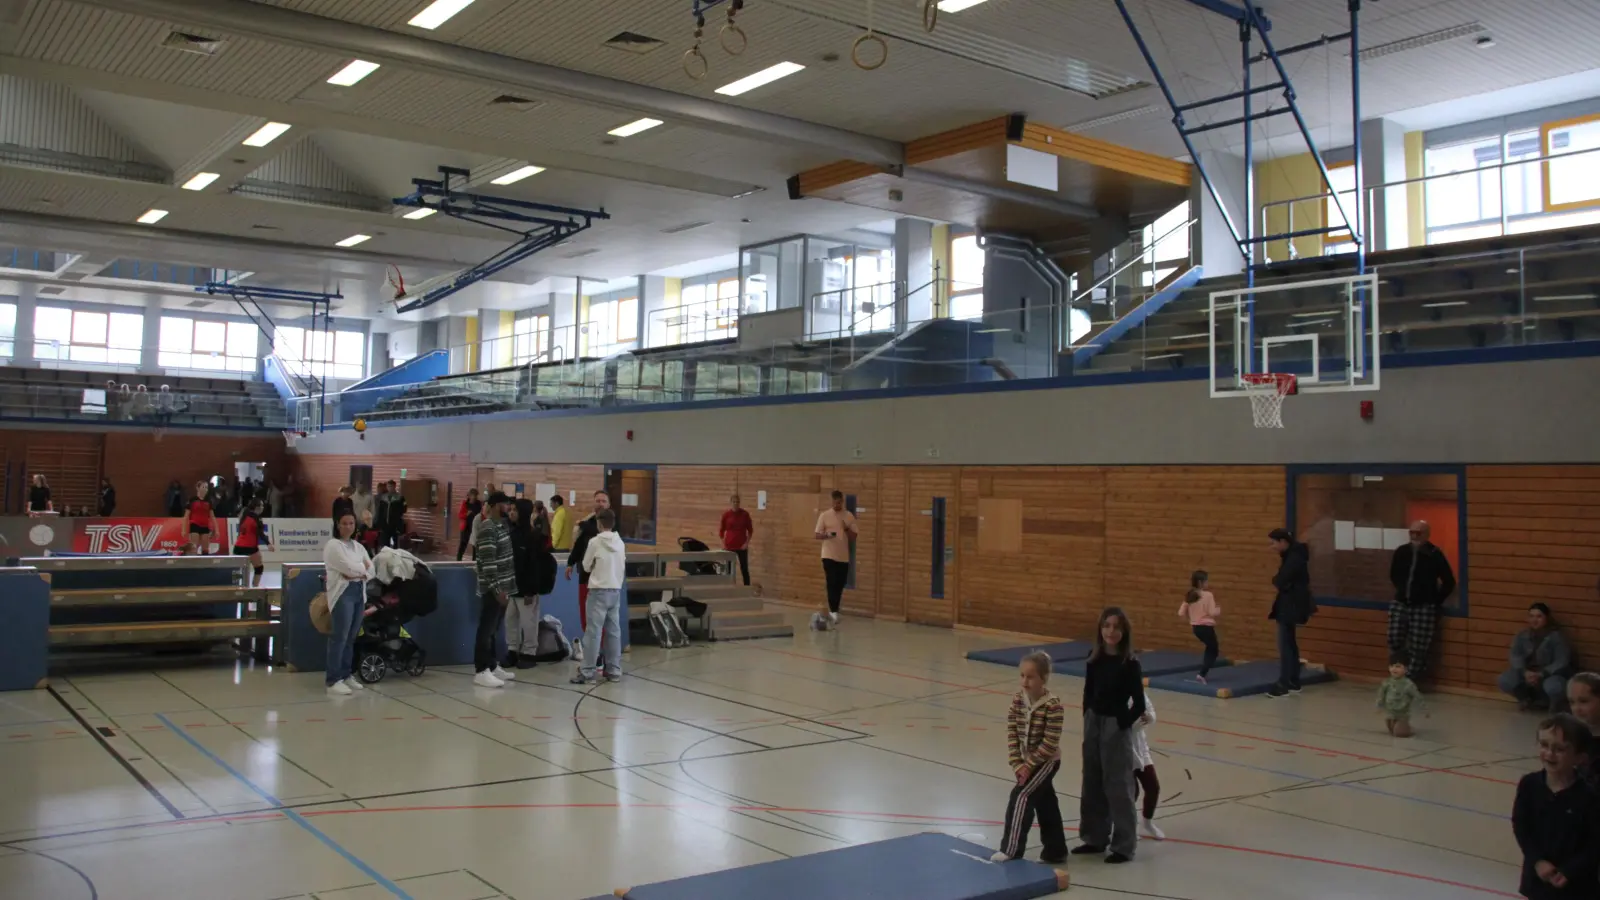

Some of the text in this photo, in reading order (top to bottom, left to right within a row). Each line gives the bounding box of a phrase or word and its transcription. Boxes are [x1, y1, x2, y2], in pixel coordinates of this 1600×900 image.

[278, 529, 330, 537] Handwerker für
[85, 524, 163, 553] TSV
[279, 538, 319, 546] Heimwerker
[160, 540, 178, 548] 1860
